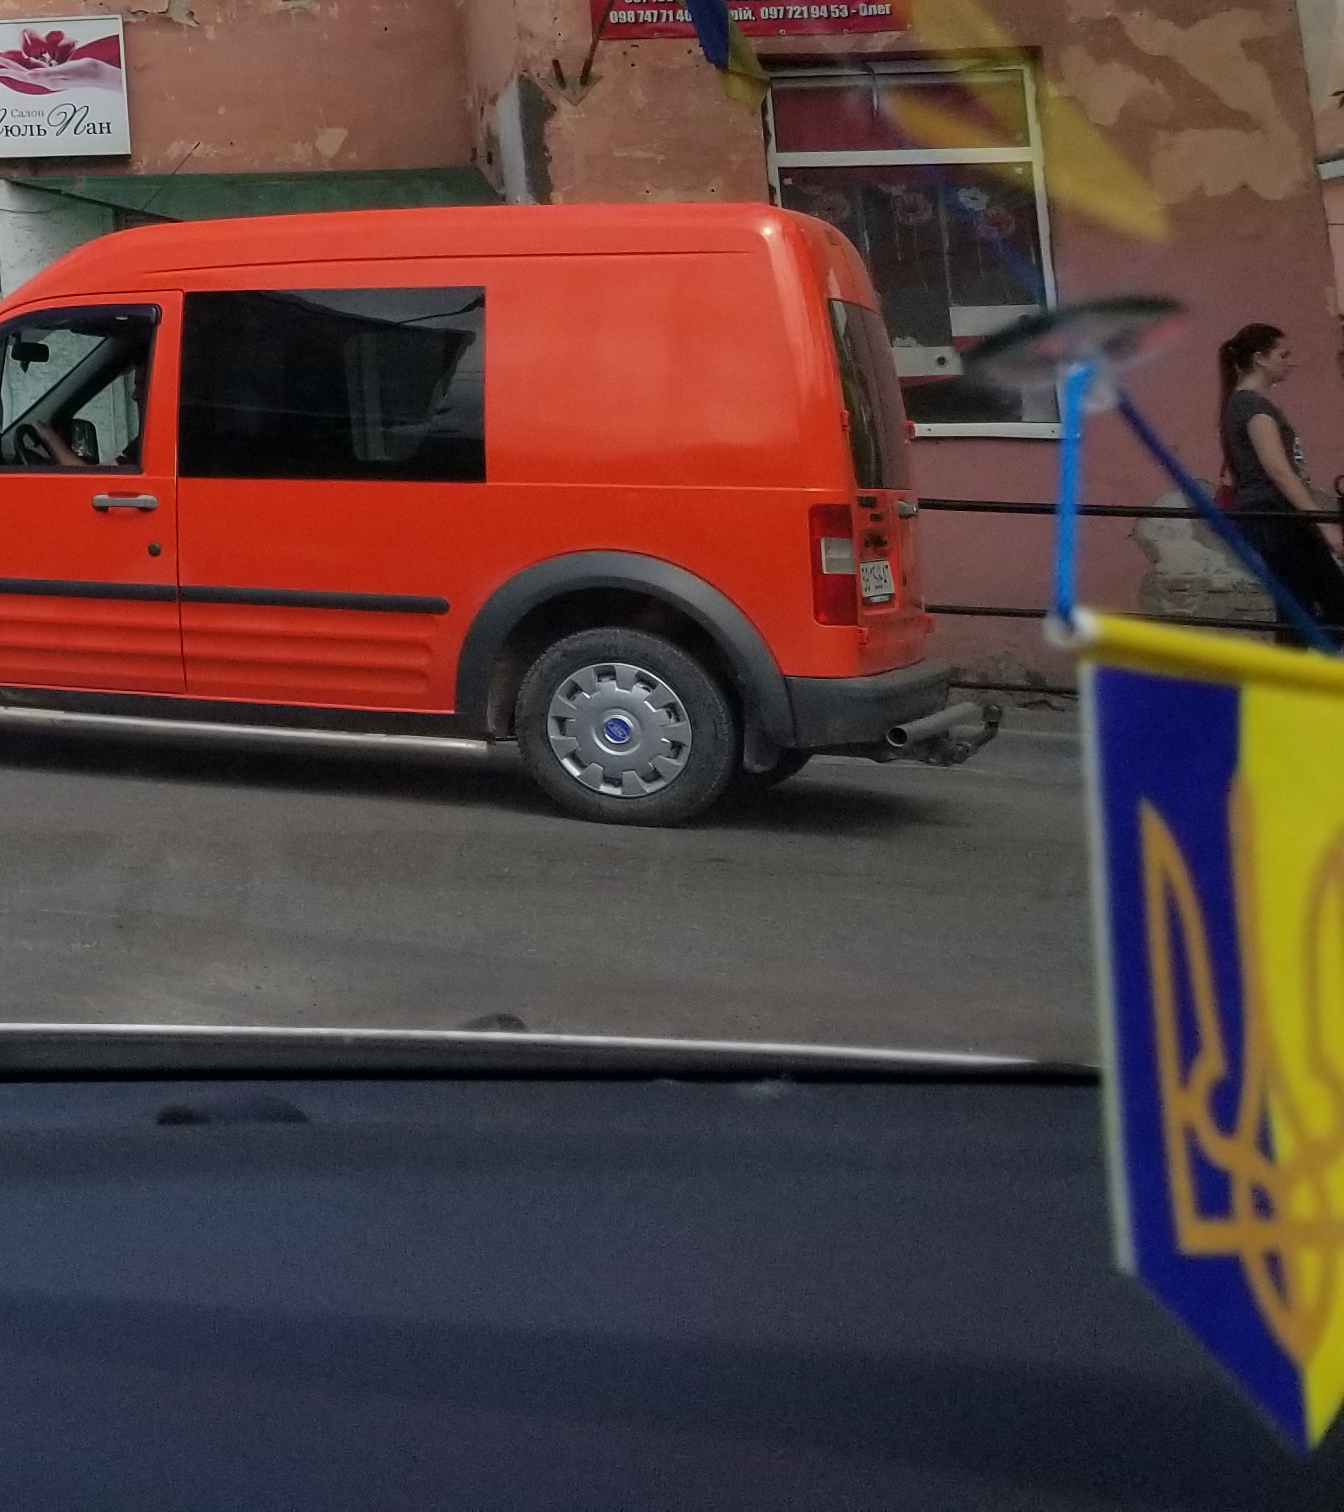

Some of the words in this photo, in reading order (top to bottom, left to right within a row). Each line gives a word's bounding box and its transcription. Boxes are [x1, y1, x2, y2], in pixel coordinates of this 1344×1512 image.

[610, 10, 635, 23] 098
[637, 10, 658, 23] 747
[661, 10, 674, 23] 71
[760, 7, 785, 20] 097
[786, 6, 808, 19] 721
[811, 5, 828, 18] 94
[830, 4, 848, 18] 53
[10, 109, 45, 118] Салон
